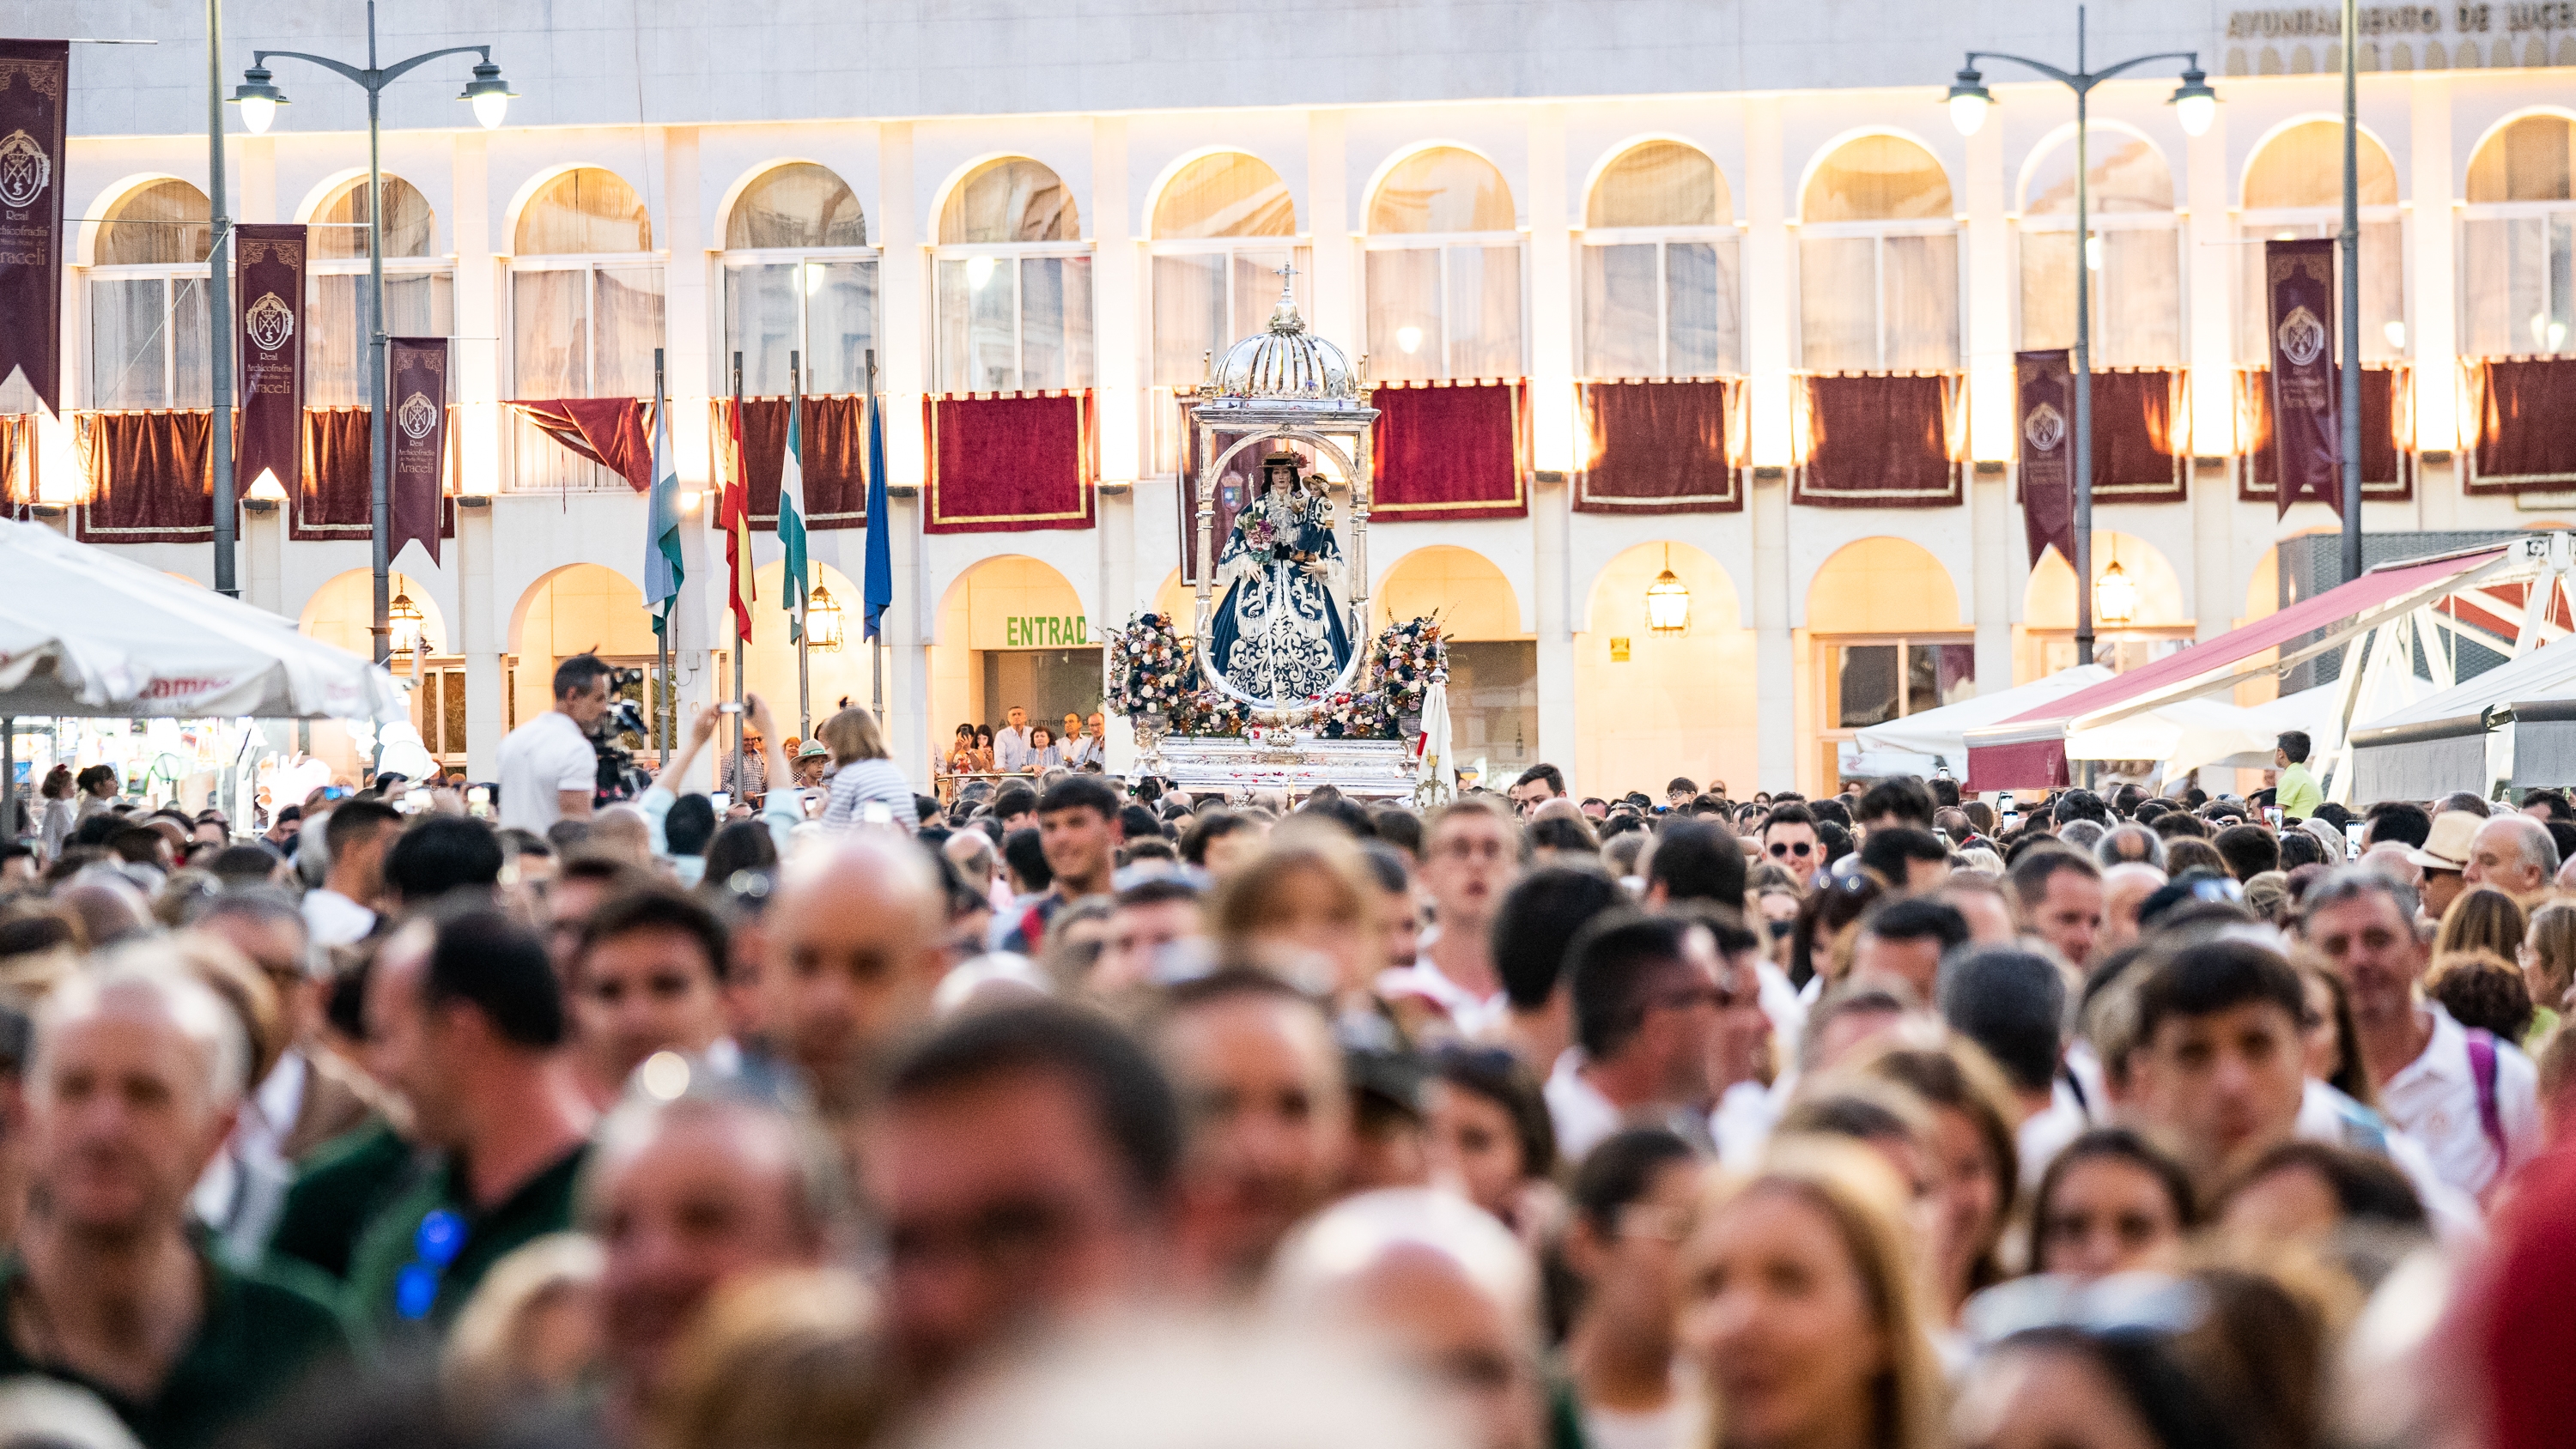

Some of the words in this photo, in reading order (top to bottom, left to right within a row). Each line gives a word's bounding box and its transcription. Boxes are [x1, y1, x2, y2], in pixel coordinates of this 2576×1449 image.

[6, 210, 29, 221] Real
[259, 352, 279, 361] Real
[249, 379, 291, 394] Araceli
[398, 462, 434, 473] Araceli
[1007, 615, 1103, 646] ENTRAD
